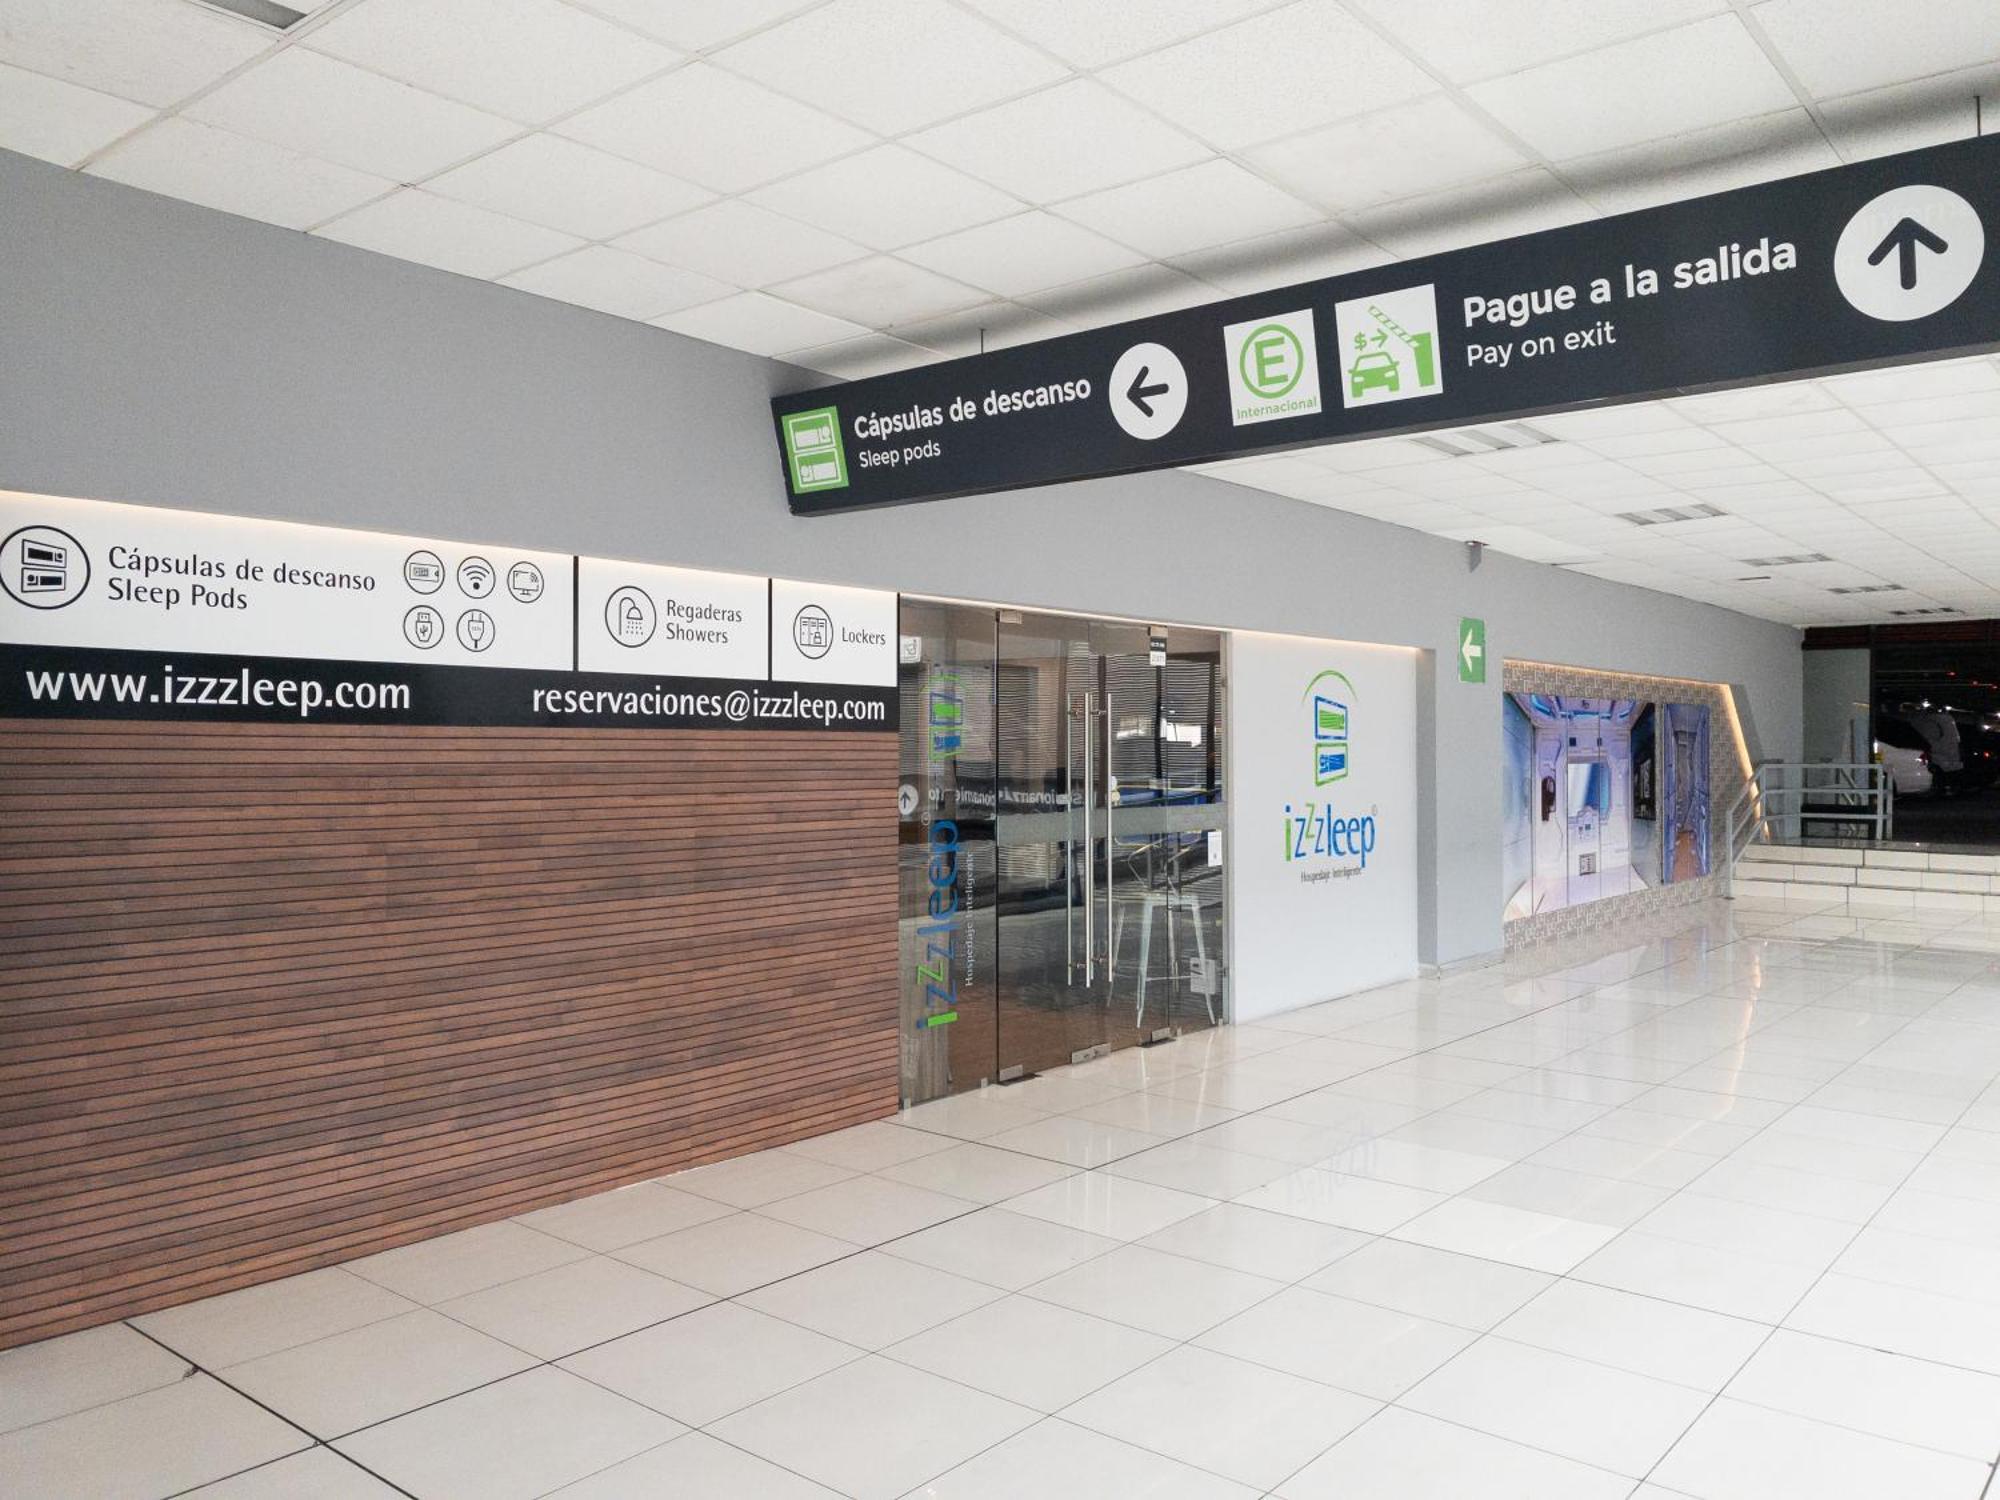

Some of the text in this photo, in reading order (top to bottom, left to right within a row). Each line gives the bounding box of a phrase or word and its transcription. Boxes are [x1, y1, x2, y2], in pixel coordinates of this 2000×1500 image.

[1463, 237, 1798, 328] Pague a la salida
[1254, 336, 1289, 387] E
[1466, 322, 1617, 369] Pay on exit
[854, 378, 1091, 441] Cápsulas de descanso
[1237, 397, 1317, 419] Internacional
[859, 439, 941, 471] Sleep pods
[108, 546, 376, 592] Cápsulas de descanso
[108, 577, 248, 611] Sleep Pods
[667, 600, 742, 624] Regaderas
[666, 622, 729, 644] Showers
[841, 627, 886, 646] Lockers
[26, 664, 411, 717] www.izzzleep.com
[532, 685, 886, 726] reservaciones@izzzleep.com
